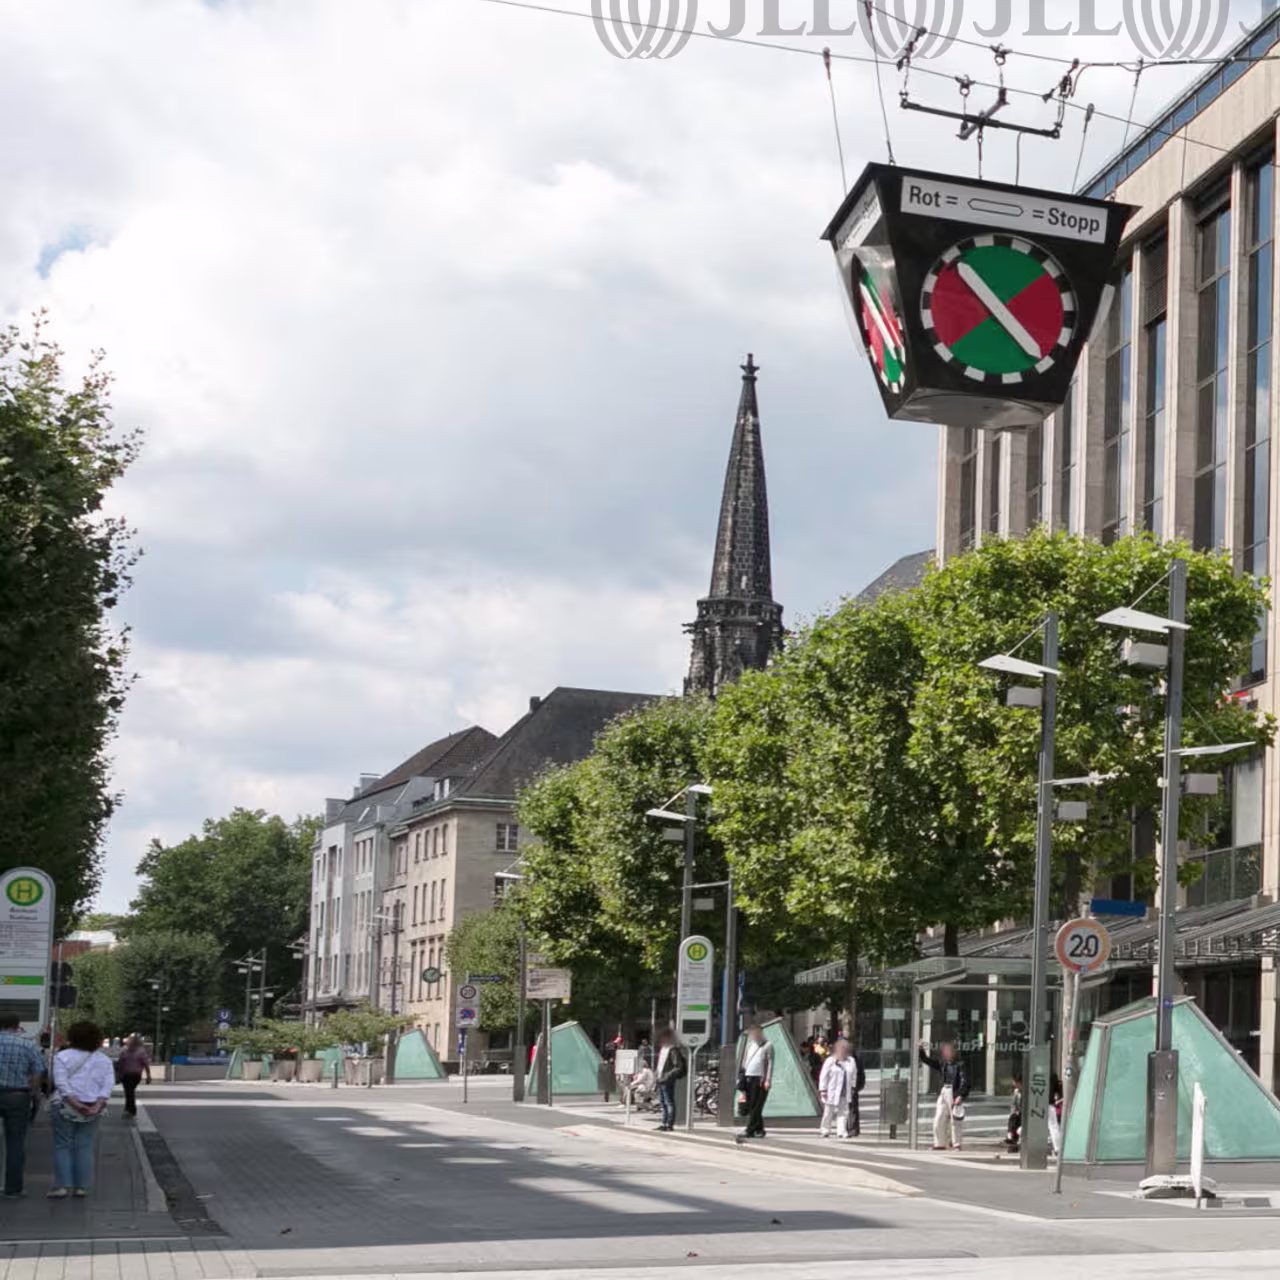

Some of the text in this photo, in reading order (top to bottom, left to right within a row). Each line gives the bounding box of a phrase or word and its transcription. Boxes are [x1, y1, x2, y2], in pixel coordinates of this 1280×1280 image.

[908, 185, 941, 208] Rot
[1047, 208, 1101, 234] Stopp
[16, 882, 33, 900] H
[1069, 934, 1100, 958] 20
